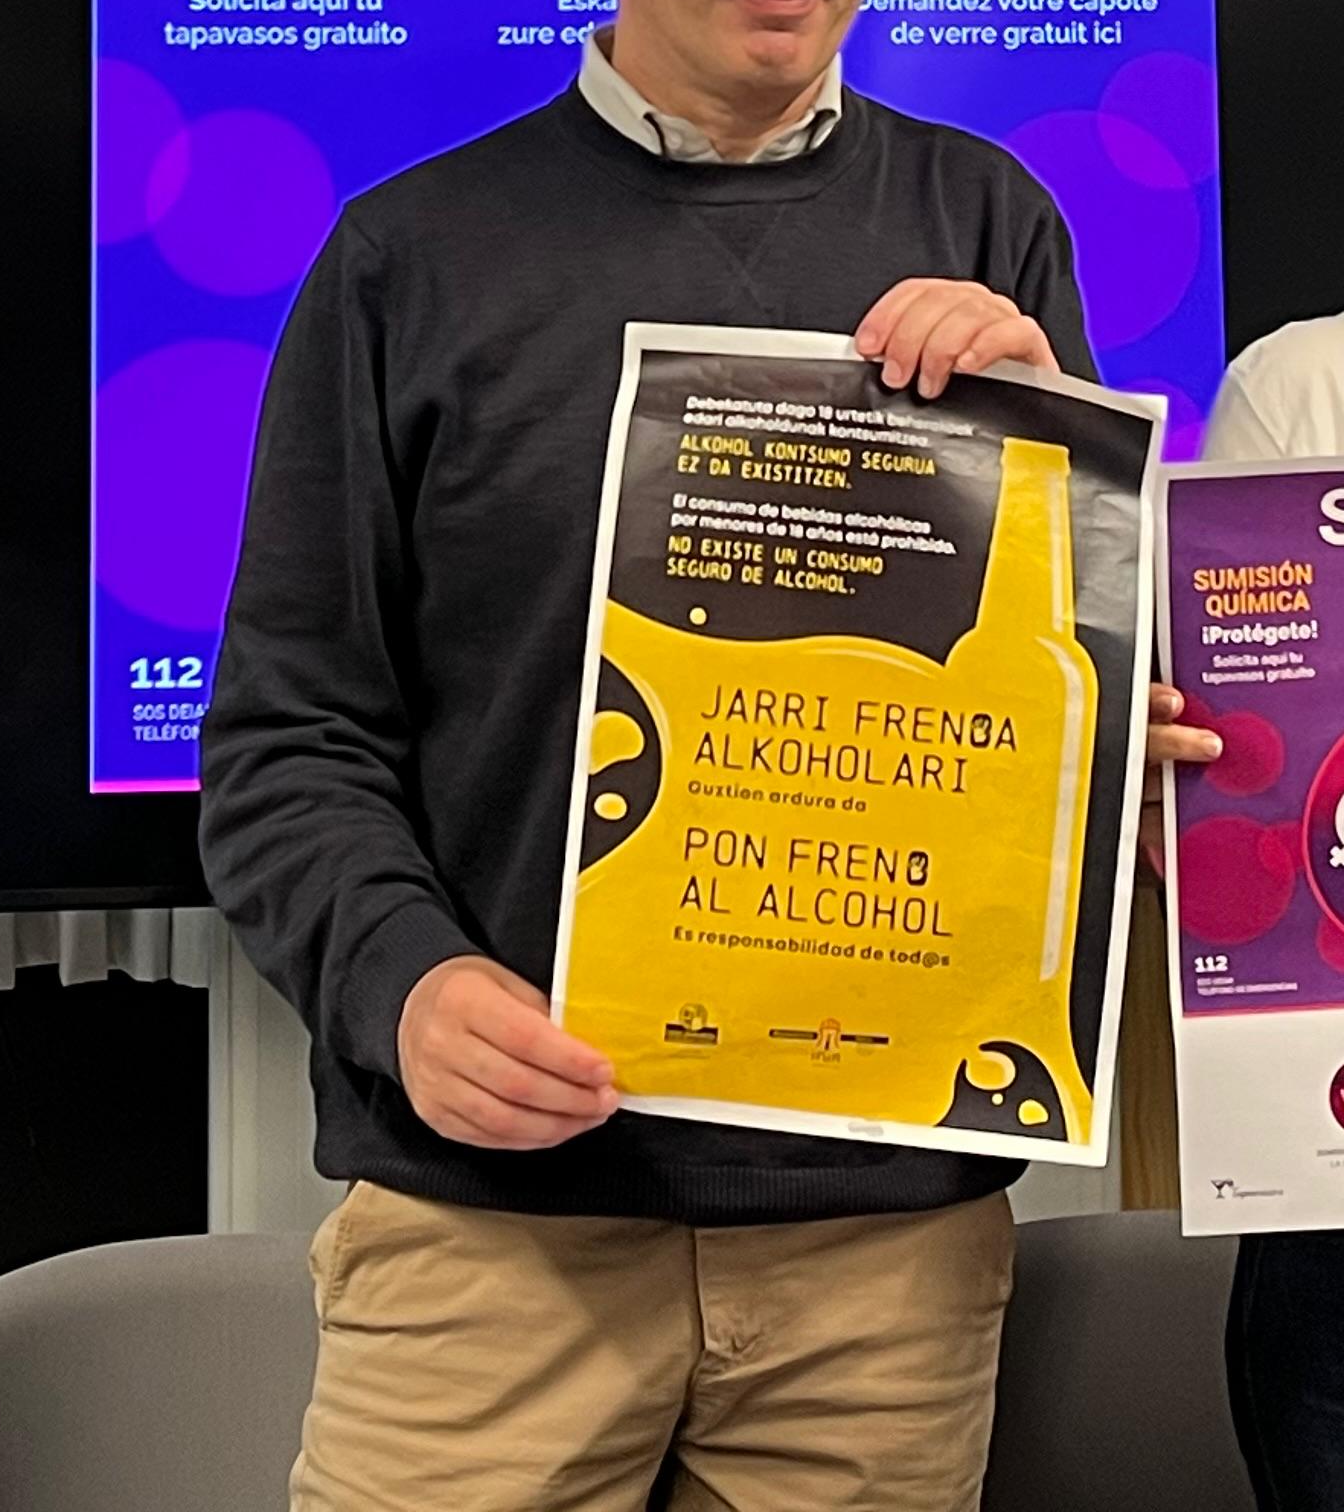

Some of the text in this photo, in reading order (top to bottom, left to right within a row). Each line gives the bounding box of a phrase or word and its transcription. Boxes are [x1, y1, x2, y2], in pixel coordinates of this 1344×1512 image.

[164, 20, 408, 50] tapavasos gratuito
[497, 26, 555, 45] zure
[890, 20, 1122, 49] de verre gratuit ici
[680, 433, 936, 476] ALKOHOL KONTSUMO SEGURUA
[677, 454, 852, 489] EZ DA EXISTITZEN.
[670, 513, 698, 528] por
[699, 516, 764, 534] menores
[766, 522, 787, 536] de
[688, 497, 756, 515] consumo
[758, 503, 779, 518] de
[781, 504, 843, 525] bebidas
[668, 535, 883, 575] NO EXISTE UN CONSUMO
[666, 557, 855, 595] SEGURO DE ALCOHOL.
[1193, 559, 1313, 591] SUMISIÓN
[1205, 589, 1311, 618] QUÍMICA
[129, 656, 203, 689] 112
[133, 704, 166, 721] SOS
[700, 684, 829, 732] JARRI
[693, 731, 968, 794] ALKOHOLARI
[769, 789, 836, 810] ardura
[842, 794, 867, 812] da
[684, 827, 767, 869] PON
[679, 875, 953, 938] AL ALCOHOL
[674, 926, 950, 968] Es responsabilidad de tod@s
[1194, 955, 1228, 973] 112
